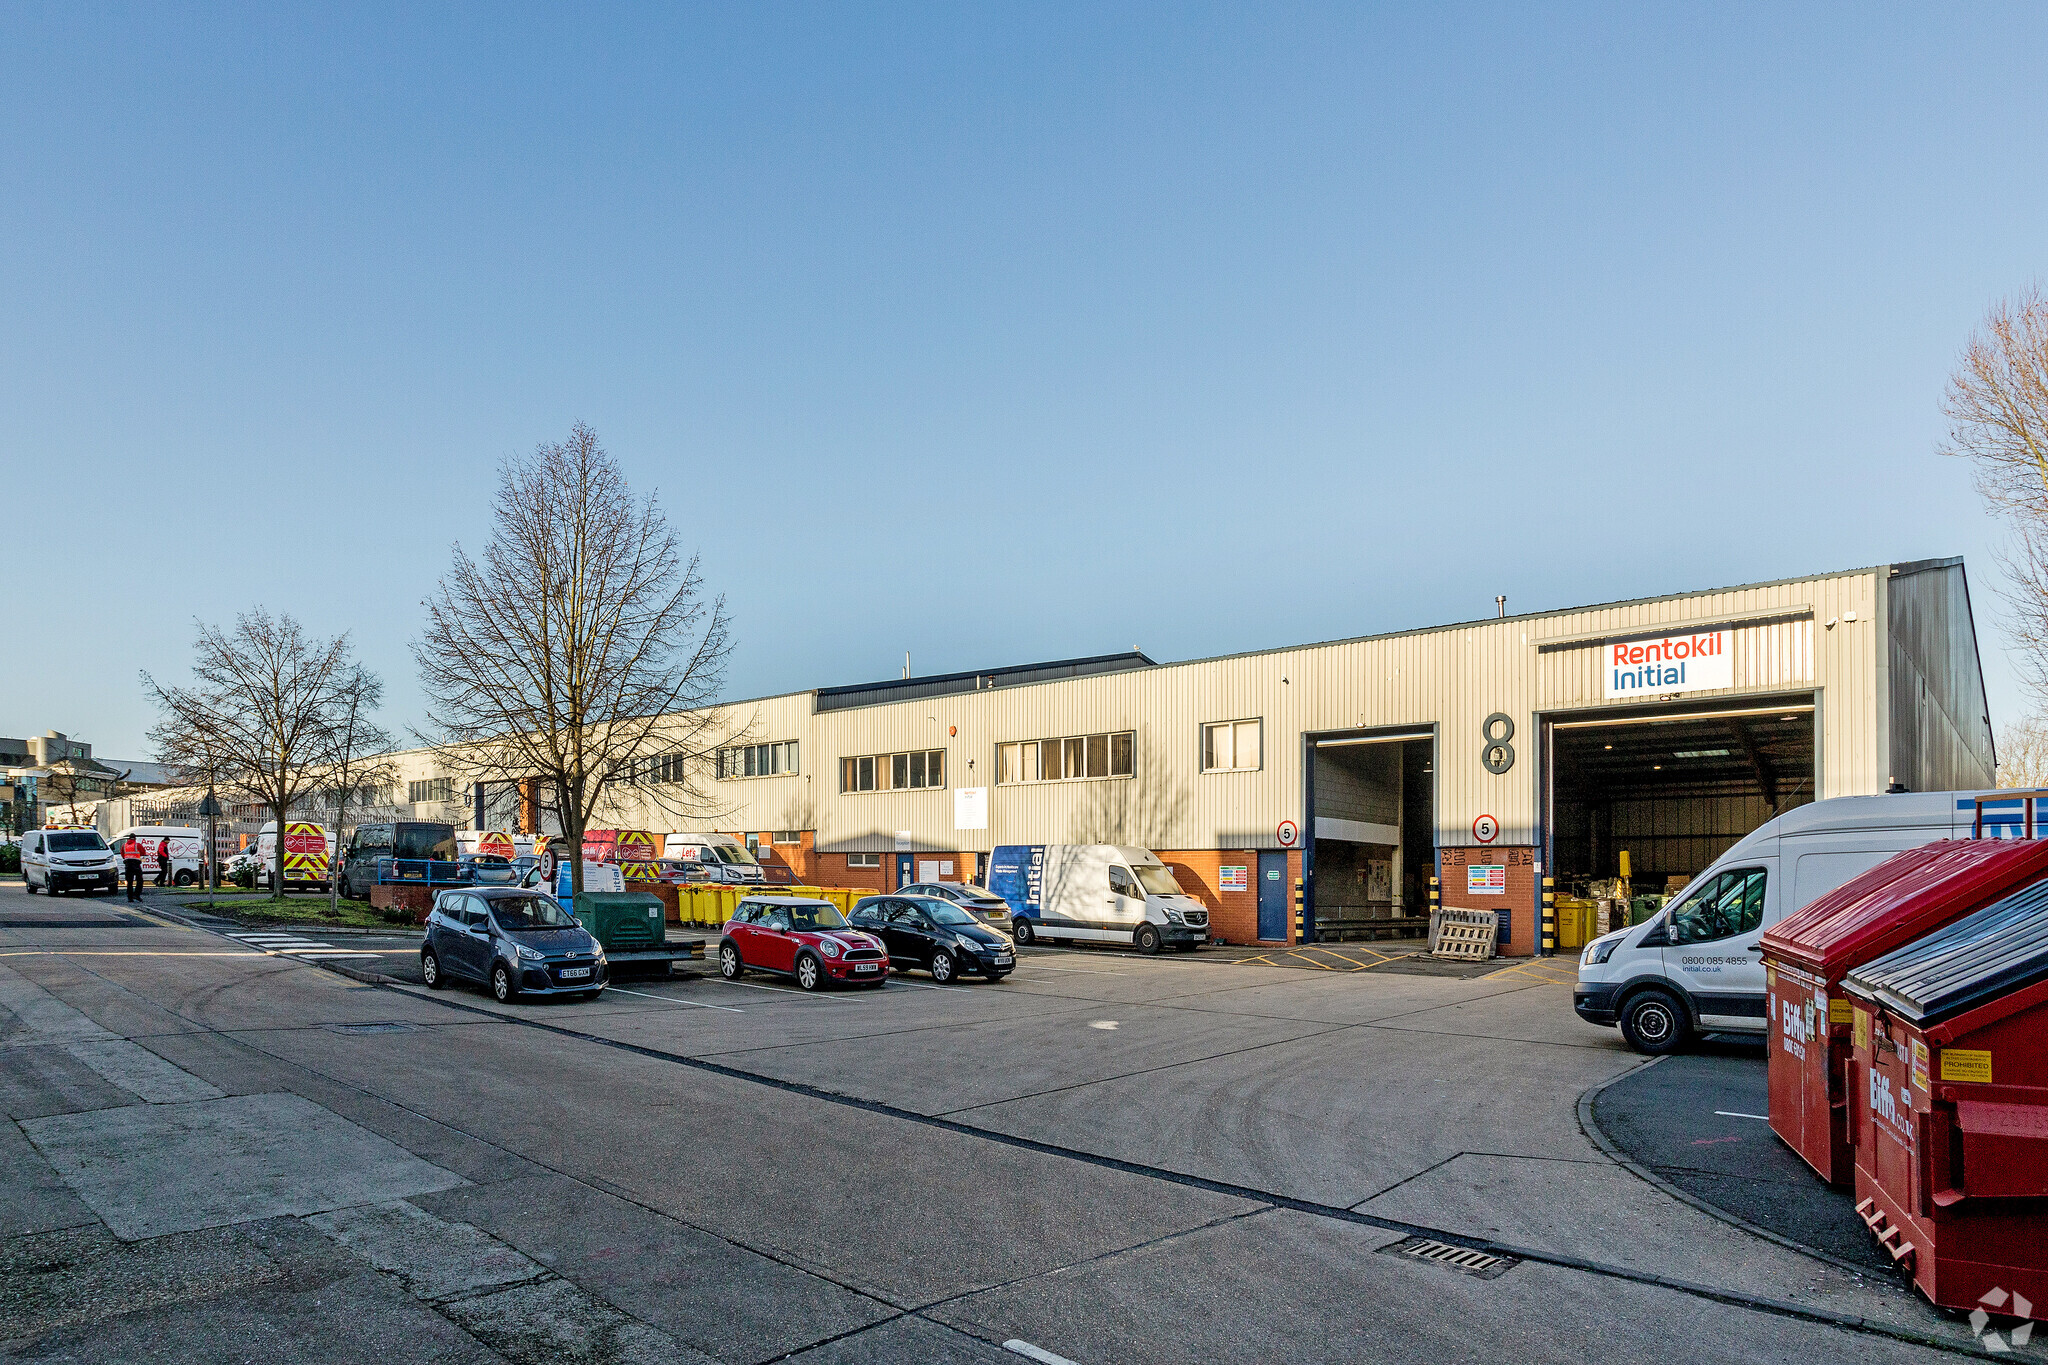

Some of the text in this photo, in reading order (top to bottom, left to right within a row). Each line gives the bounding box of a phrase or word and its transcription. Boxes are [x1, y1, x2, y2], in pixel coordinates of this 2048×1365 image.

[1613, 632, 1721, 666] Rentokil
[1614, 661, 1685, 690] Initial
[1482, 712, 1515, 775] 8
[1283, 828, 1291, 839] 5
[1481, 823, 1489, 835] 5
[682, 847, 696, 858] Let's
[543, 854, 549, 869] 5
[611, 868, 622, 892] nitial
[1026, 848, 1044, 905] Initial
[1682, 957, 1748, 966] 0800 085 4855
[1682, 965, 1722, 973] initial.co.uk
[1944, 1061, 1989, 1069] PROHIBITED
